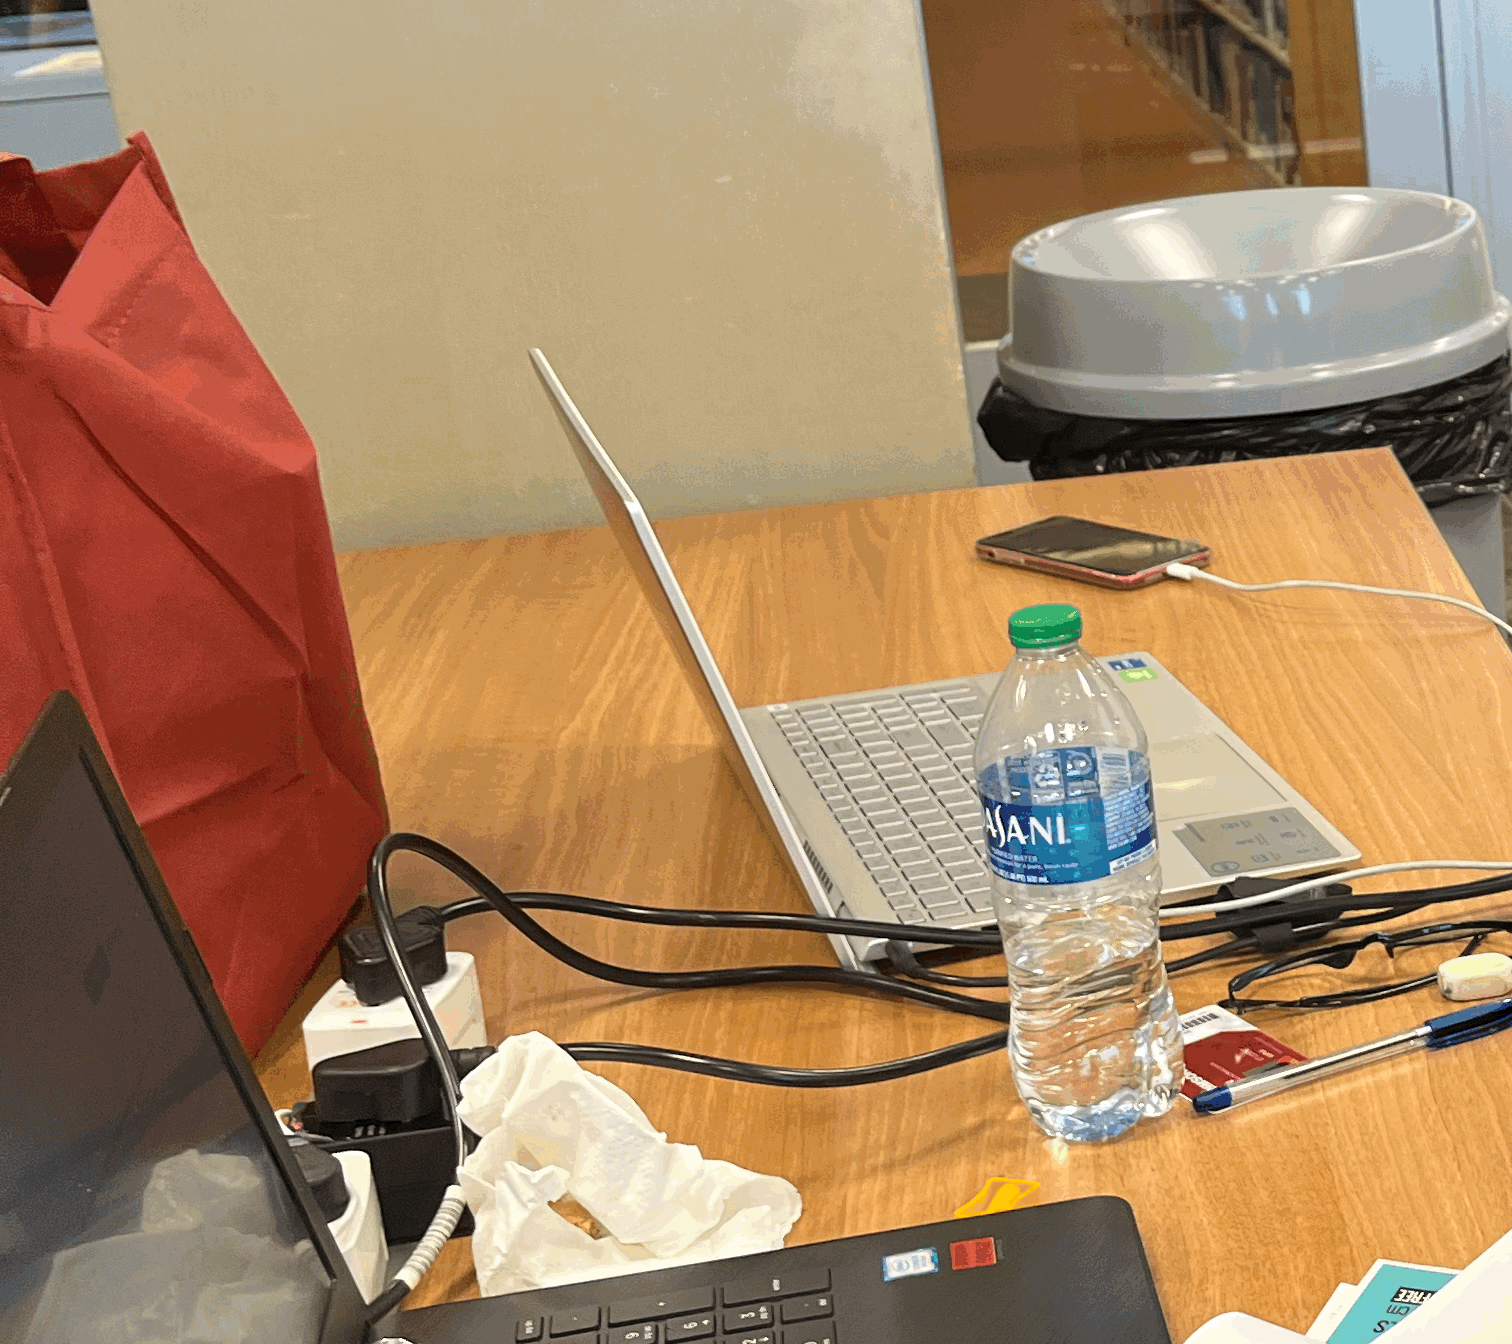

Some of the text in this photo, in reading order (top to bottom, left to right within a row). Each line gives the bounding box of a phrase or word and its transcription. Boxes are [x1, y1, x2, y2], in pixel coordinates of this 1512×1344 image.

[985, 805, 1066, 848] ASANI
[1393, 1288, 1432, 1305] FREE
[740, 1311, 756, 1320] 3
[683, 1321, 698, 1329] 6
[625, 1332, 640, 1340] 9
